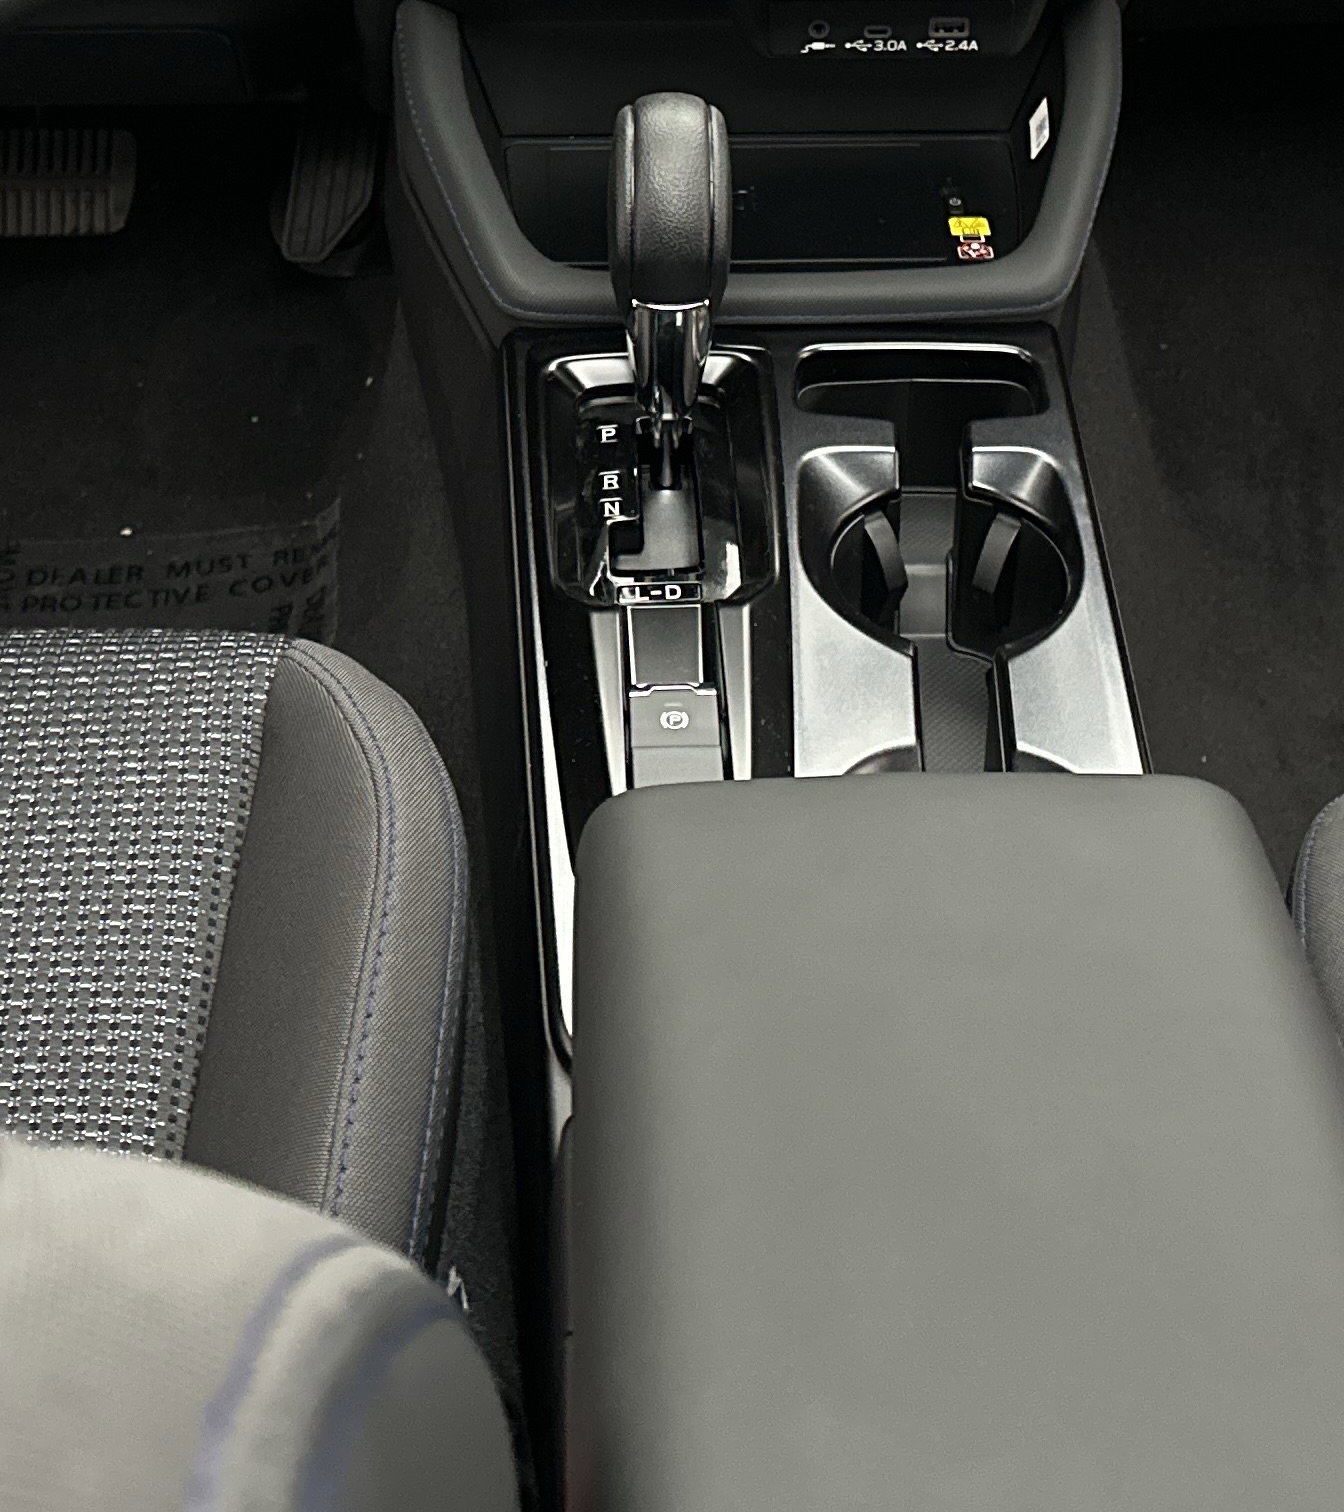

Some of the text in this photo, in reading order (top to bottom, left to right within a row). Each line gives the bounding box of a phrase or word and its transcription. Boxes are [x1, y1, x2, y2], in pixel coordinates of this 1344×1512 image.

[874, 39, 907, 51] 3.0A
[944, 39, 978, 51] 2.4A
[601, 428, 616, 442] P
[603, 475, 619, 490] R
[604, 501, 620, 517] N
[26, 564, 144, 587] DEALER
[166, 553, 253, 579] MUST
[21, 583, 208, 614] PROTECTIVE
